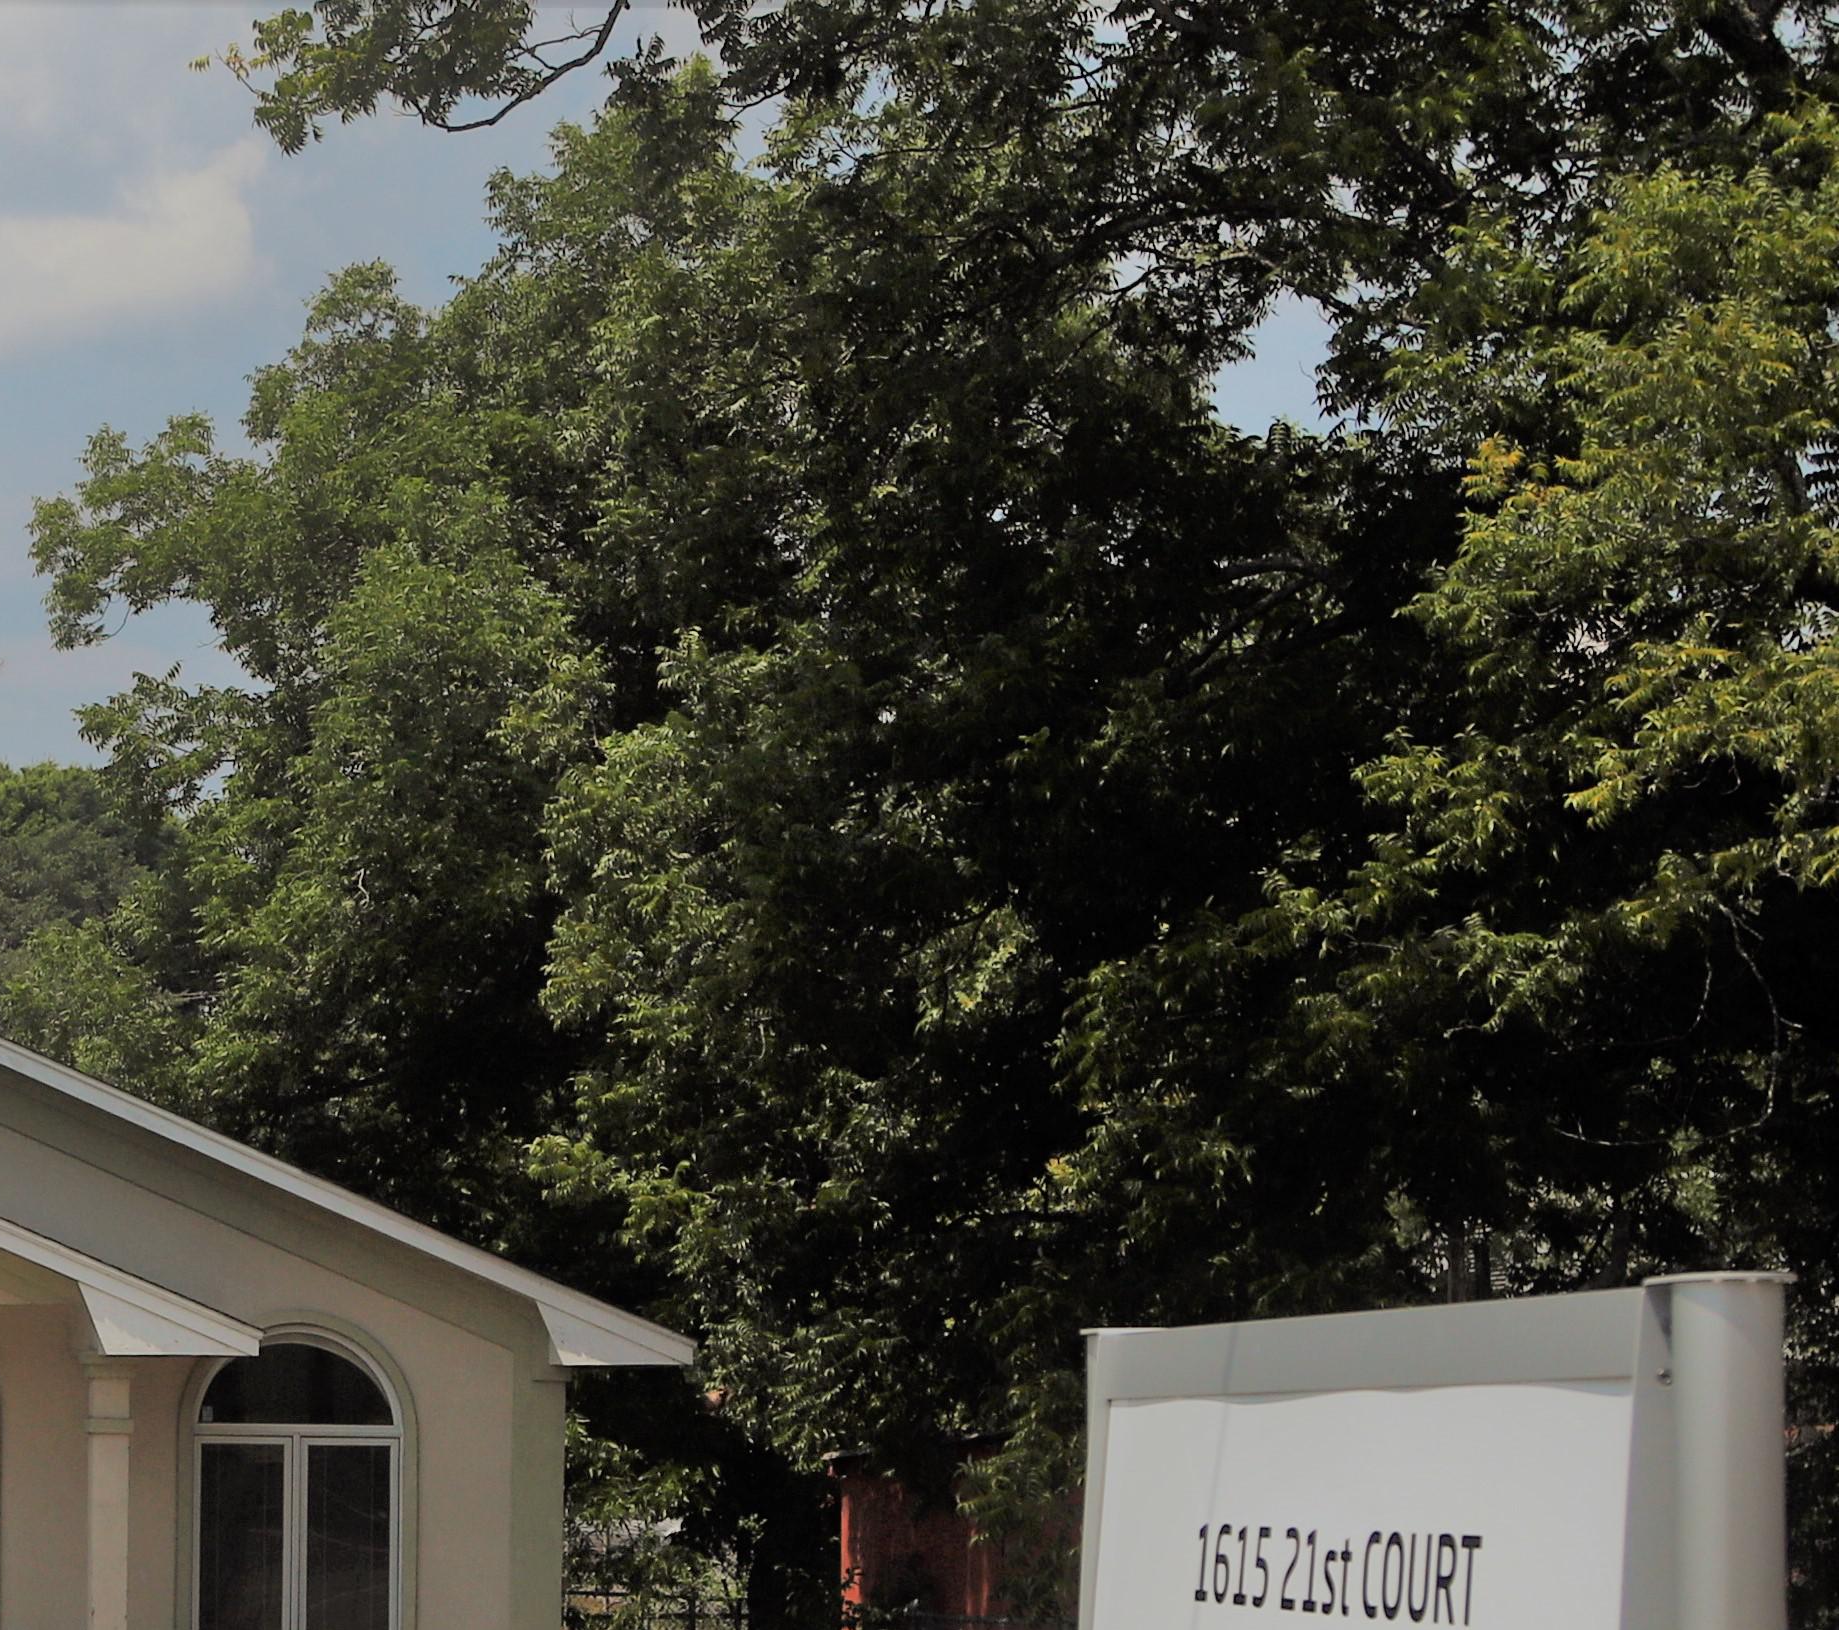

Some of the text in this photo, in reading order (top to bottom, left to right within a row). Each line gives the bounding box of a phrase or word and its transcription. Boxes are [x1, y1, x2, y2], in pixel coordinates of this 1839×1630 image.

[1194, 1523, 1483, 1627] 1615 21st COURT
